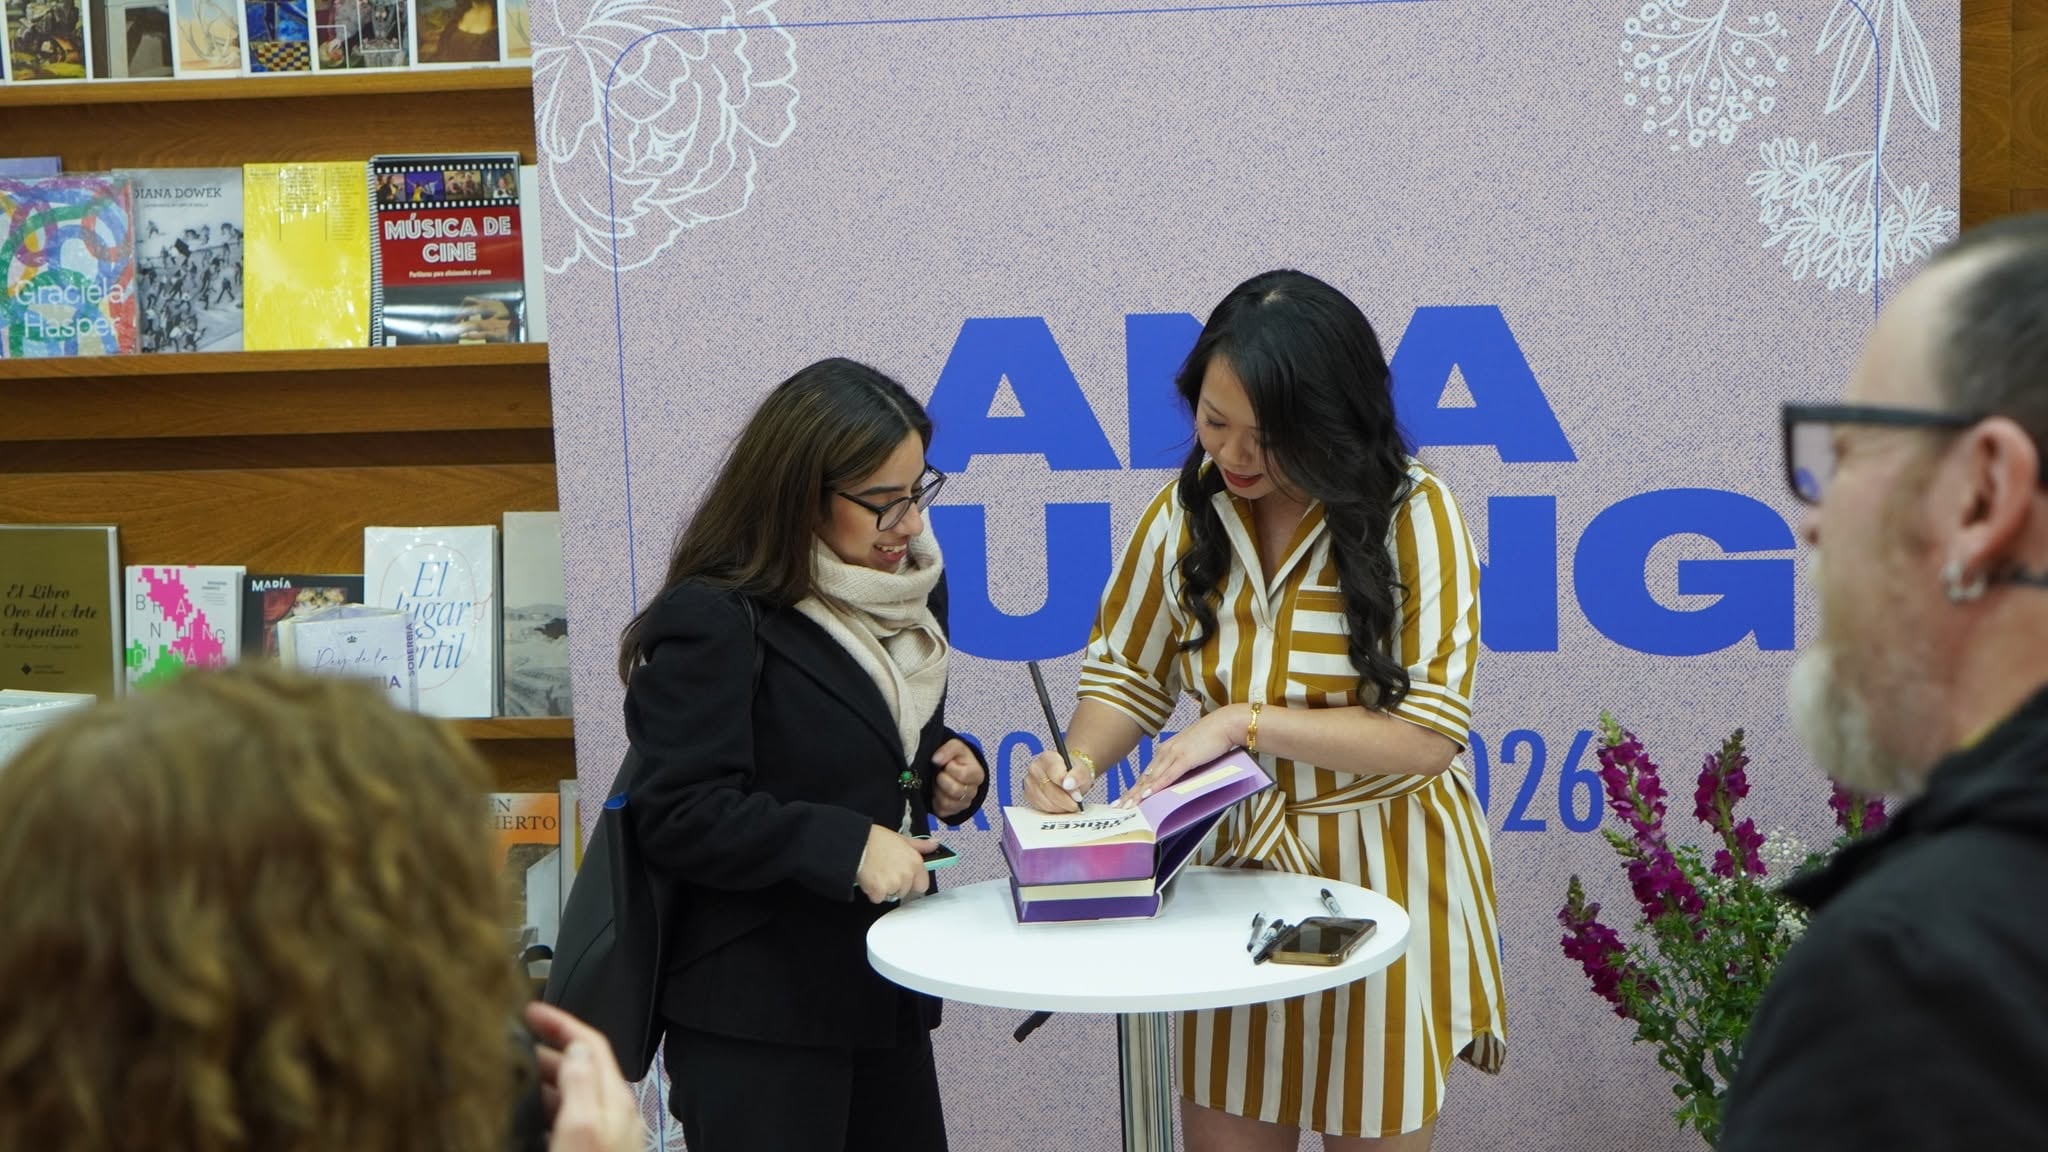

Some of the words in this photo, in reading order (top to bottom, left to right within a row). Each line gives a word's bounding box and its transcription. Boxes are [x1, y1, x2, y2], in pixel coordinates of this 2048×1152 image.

[175, 187, 222, 199] DOWEK
[384, 212, 477, 240] MÚSICA
[483, 216, 512, 236] DE
[422, 242, 476, 263] CINE
[15, 278, 125, 305] Graciela
[25, 312, 120, 343] Hasper
[412, 561, 449, 598] El
[6, 584, 24, 599] El
[29, 584, 71, 600] Libro
[3, 603, 30, 618] Oro
[36, 603, 57, 619] del
[1, 622, 79, 640] Argentino
[405, 623, 416, 677] SOBERBIA
